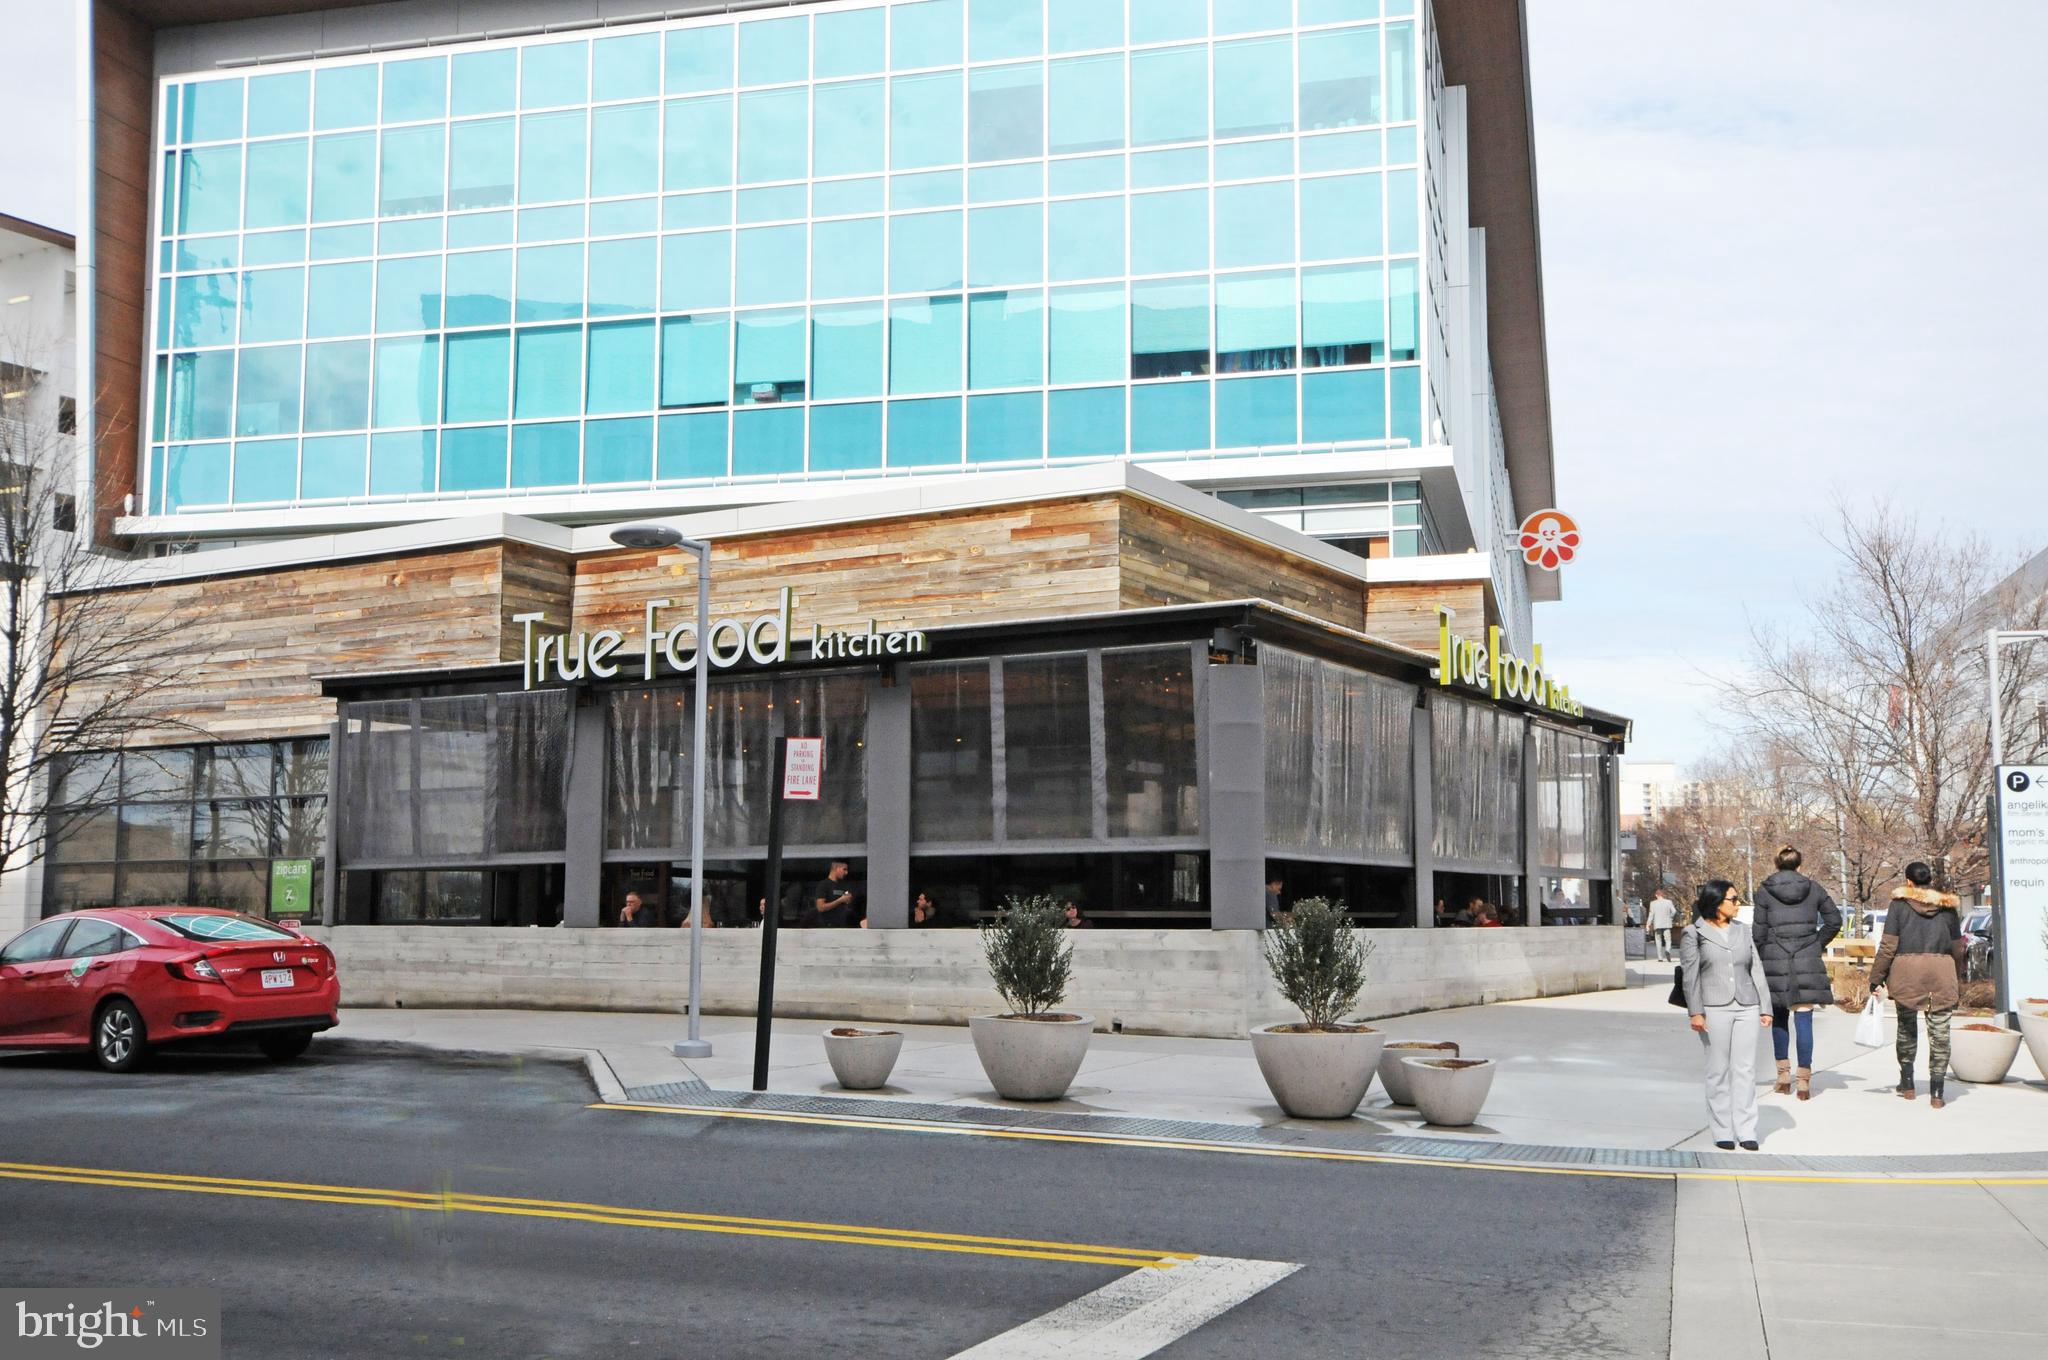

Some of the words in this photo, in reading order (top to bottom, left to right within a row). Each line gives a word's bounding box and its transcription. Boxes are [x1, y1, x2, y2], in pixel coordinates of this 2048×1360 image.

[513, 611, 624, 691] True
[644, 586, 792, 681] Food
[811, 618, 927, 660] kitchen
[1434, 604, 1488, 688] True
[1489, 625, 1547, 706] Food
[791, 764, 814, 772] STANDING
[787, 776, 800, 784] FIRE
[802, 776, 816, 784] LANE
[2007, 800, 2048, 811] angelik
[2008, 828, 2045, 837] mom's
[276, 864, 306, 875] zipcars
[2009, 877, 2045, 888] requin
